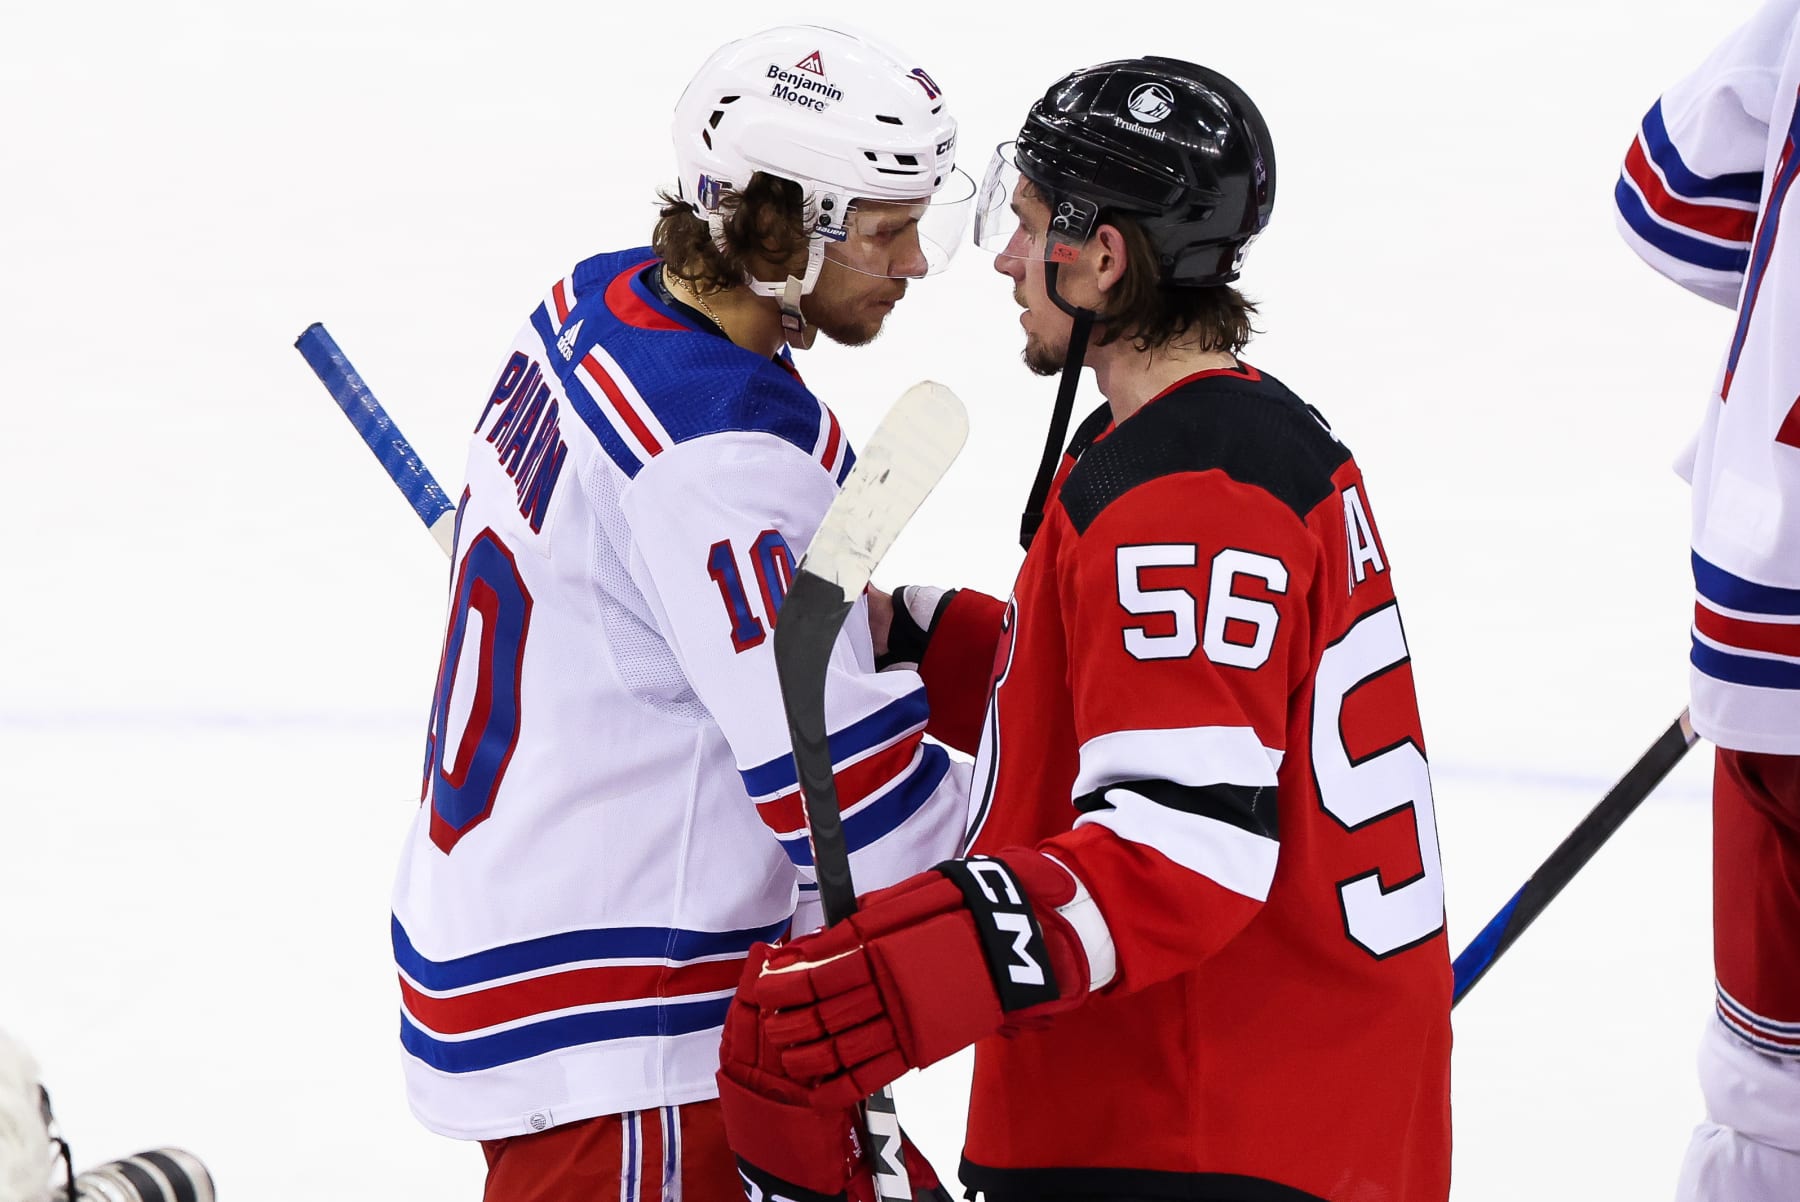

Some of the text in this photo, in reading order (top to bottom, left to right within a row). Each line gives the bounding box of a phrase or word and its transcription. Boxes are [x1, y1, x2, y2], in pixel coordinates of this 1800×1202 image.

[767, 64, 842, 101] Benjamin
[772, 83, 825, 111] Moore
[1114, 115, 1167, 141] Prudential
[1115, 542, 1289, 671] 56
[966, 854, 1046, 986] CM
